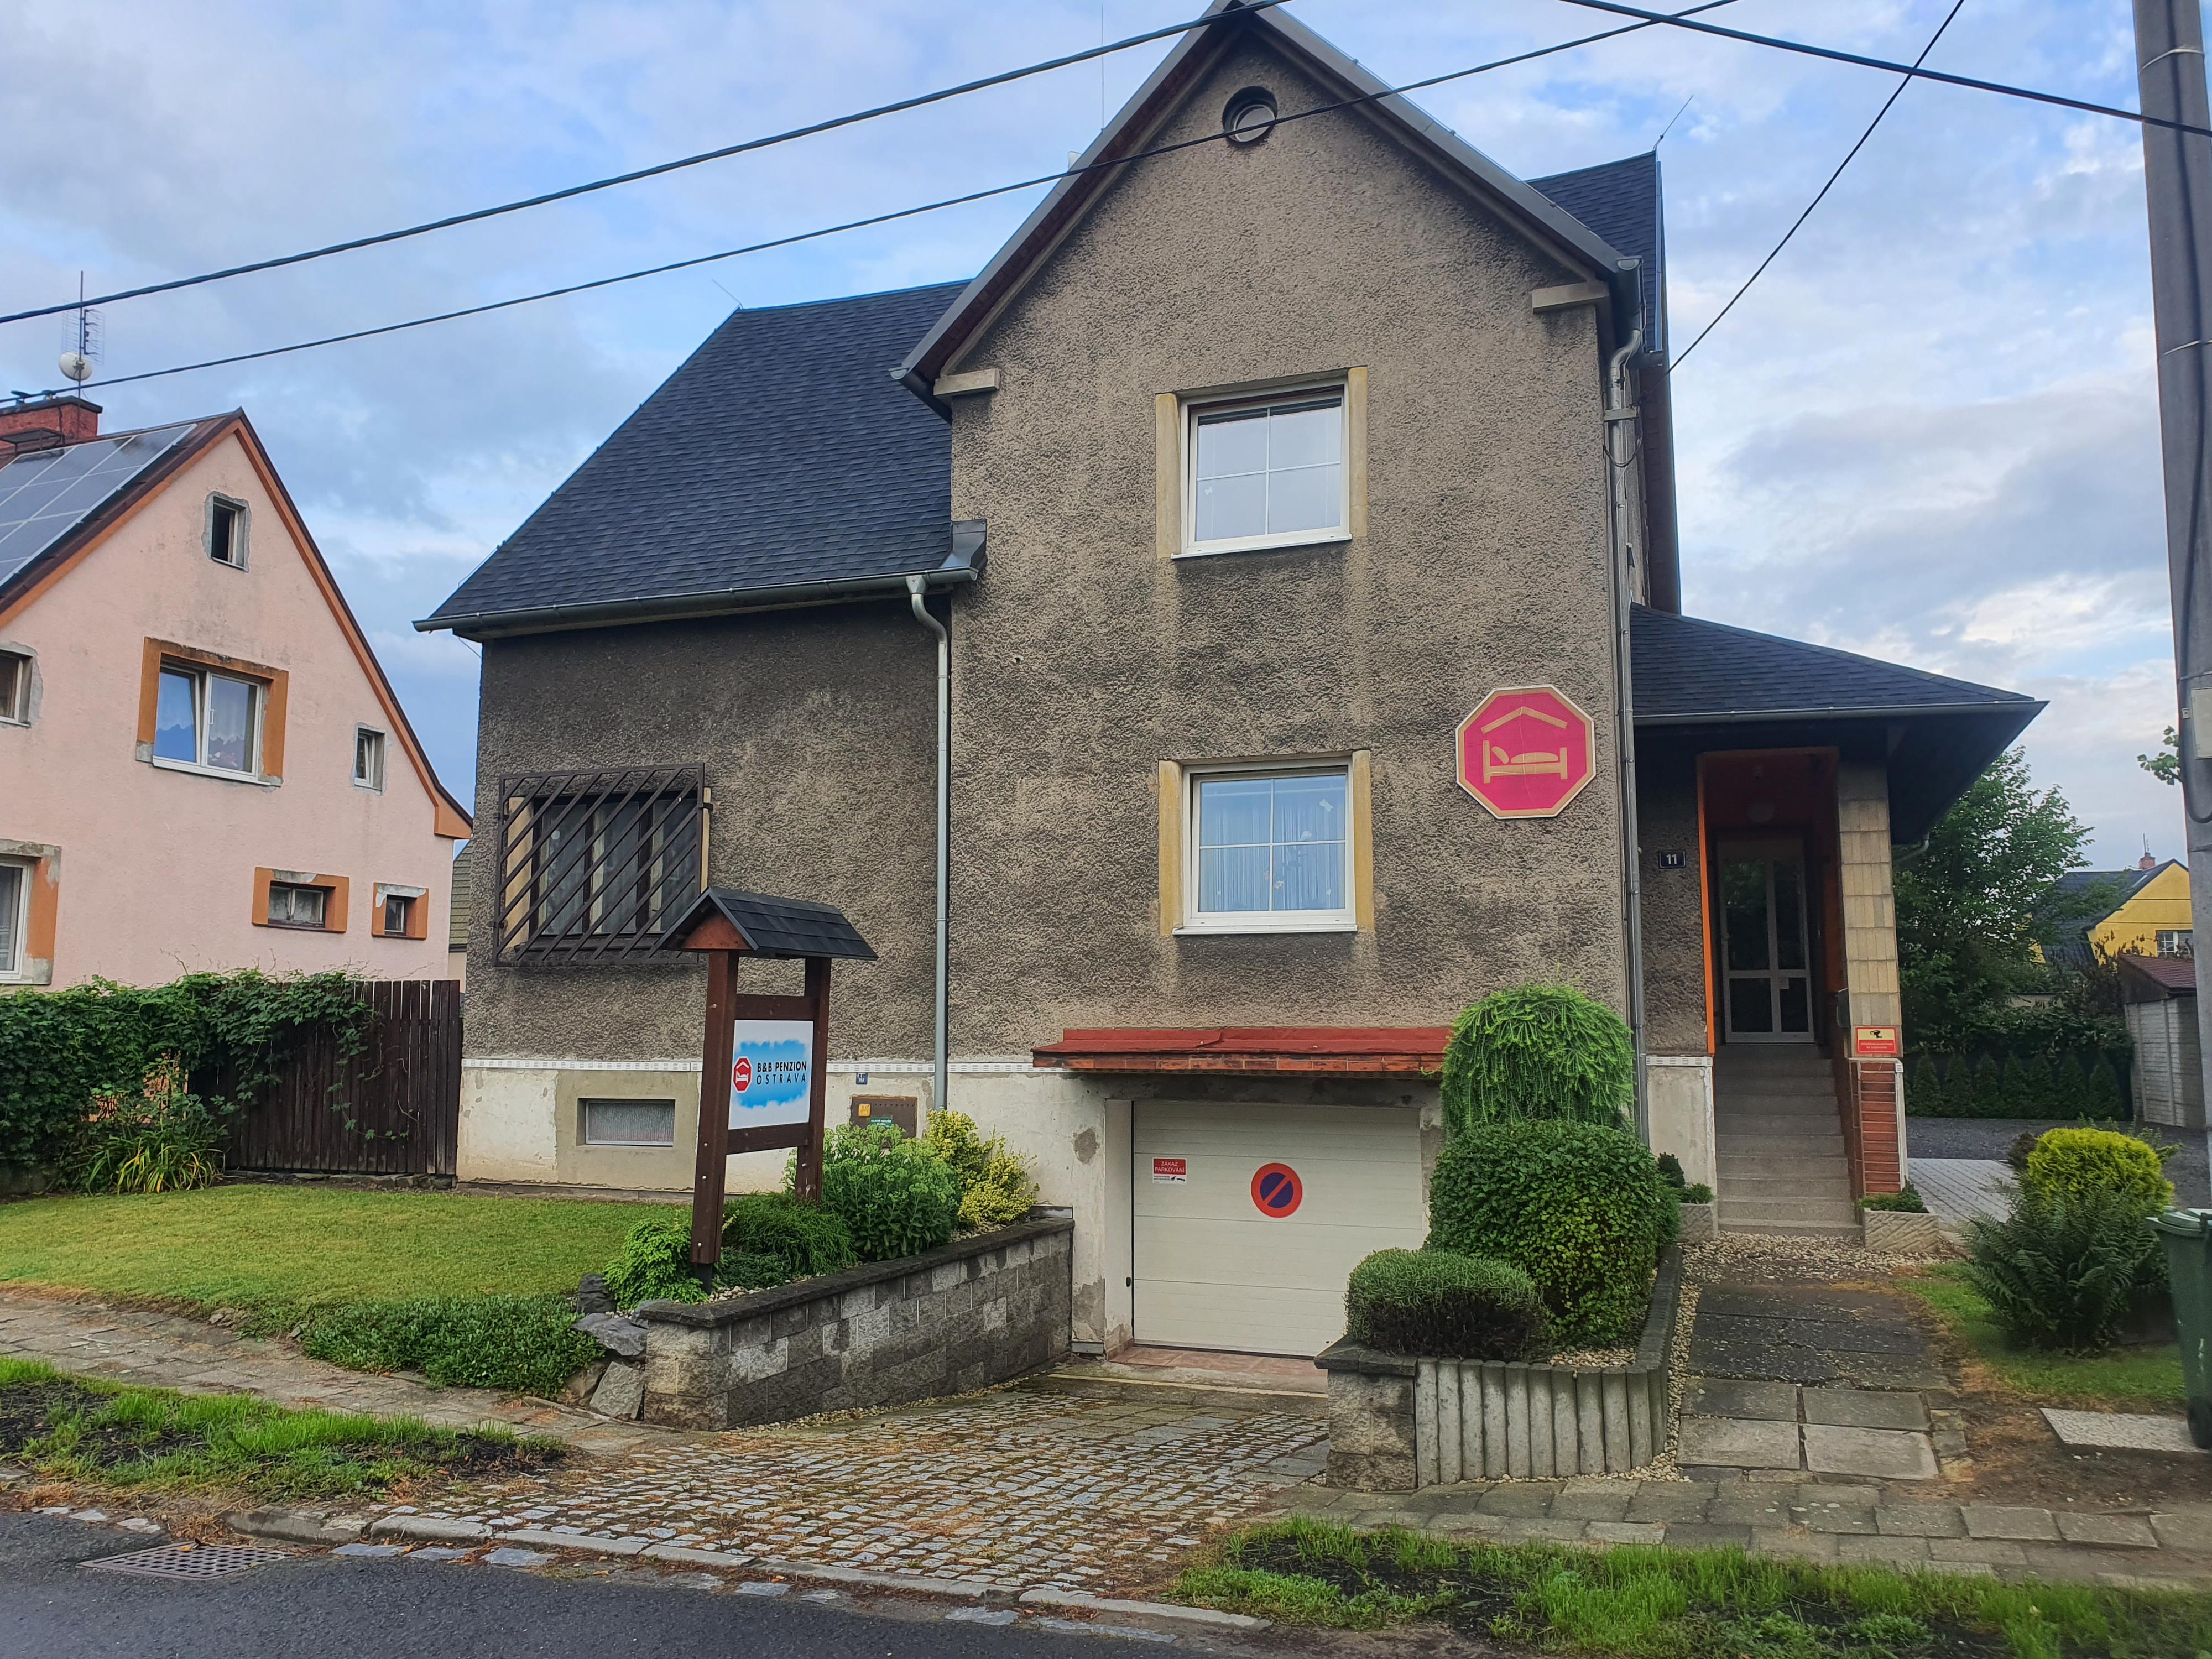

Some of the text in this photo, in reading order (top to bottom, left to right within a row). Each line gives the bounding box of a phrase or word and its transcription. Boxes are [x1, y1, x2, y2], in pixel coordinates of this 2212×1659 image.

[1666, 854, 1677, 865] 11
[757, 1061, 807, 1072] B&B PENZION
[757, 1072, 806, 1085] OSTRAVA
